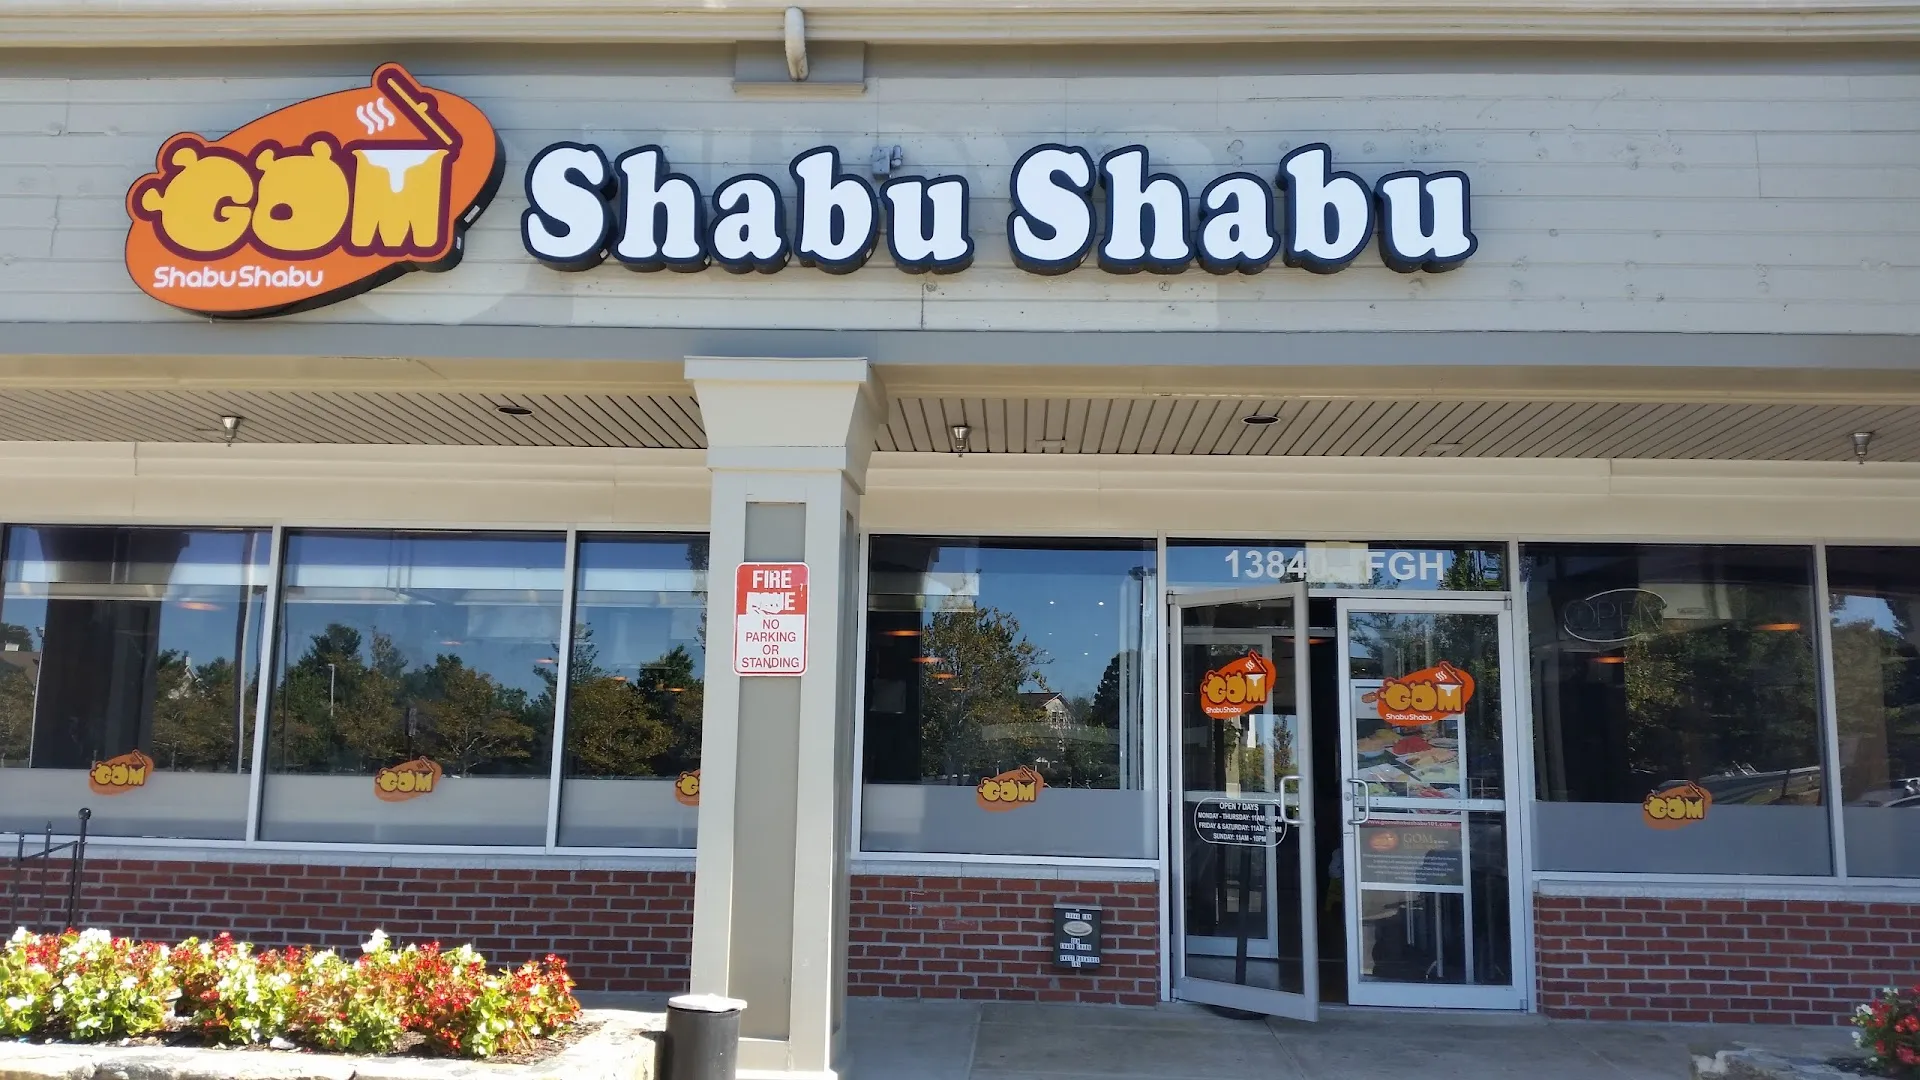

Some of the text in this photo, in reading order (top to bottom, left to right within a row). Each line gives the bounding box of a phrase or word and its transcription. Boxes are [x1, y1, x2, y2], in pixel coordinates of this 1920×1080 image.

[142, 141, 450, 252] GOM
[525, 144, 1475, 263] Shabu Shabu
[1366, 551, 1444, 580] FGH
[752, 569, 792, 589] FIRE
[762, 619, 780, 630] NO
[745, 631, 796, 642] PARKING
[762, 644, 779, 655] OR
[741, 657, 800, 668] STANDING
[1203, 672, 1267, 703] GOM
[1380, 681, 1462, 711] GOM
[92, 763, 146, 785] GOM
[376, 769, 434, 792] GOM
[978, 779, 1036, 801] GOM
[1219, 801, 1237, 810] OPEN
[1242, 803, 1259, 811] DAYS
[1644, 795, 1704, 819] GOM
